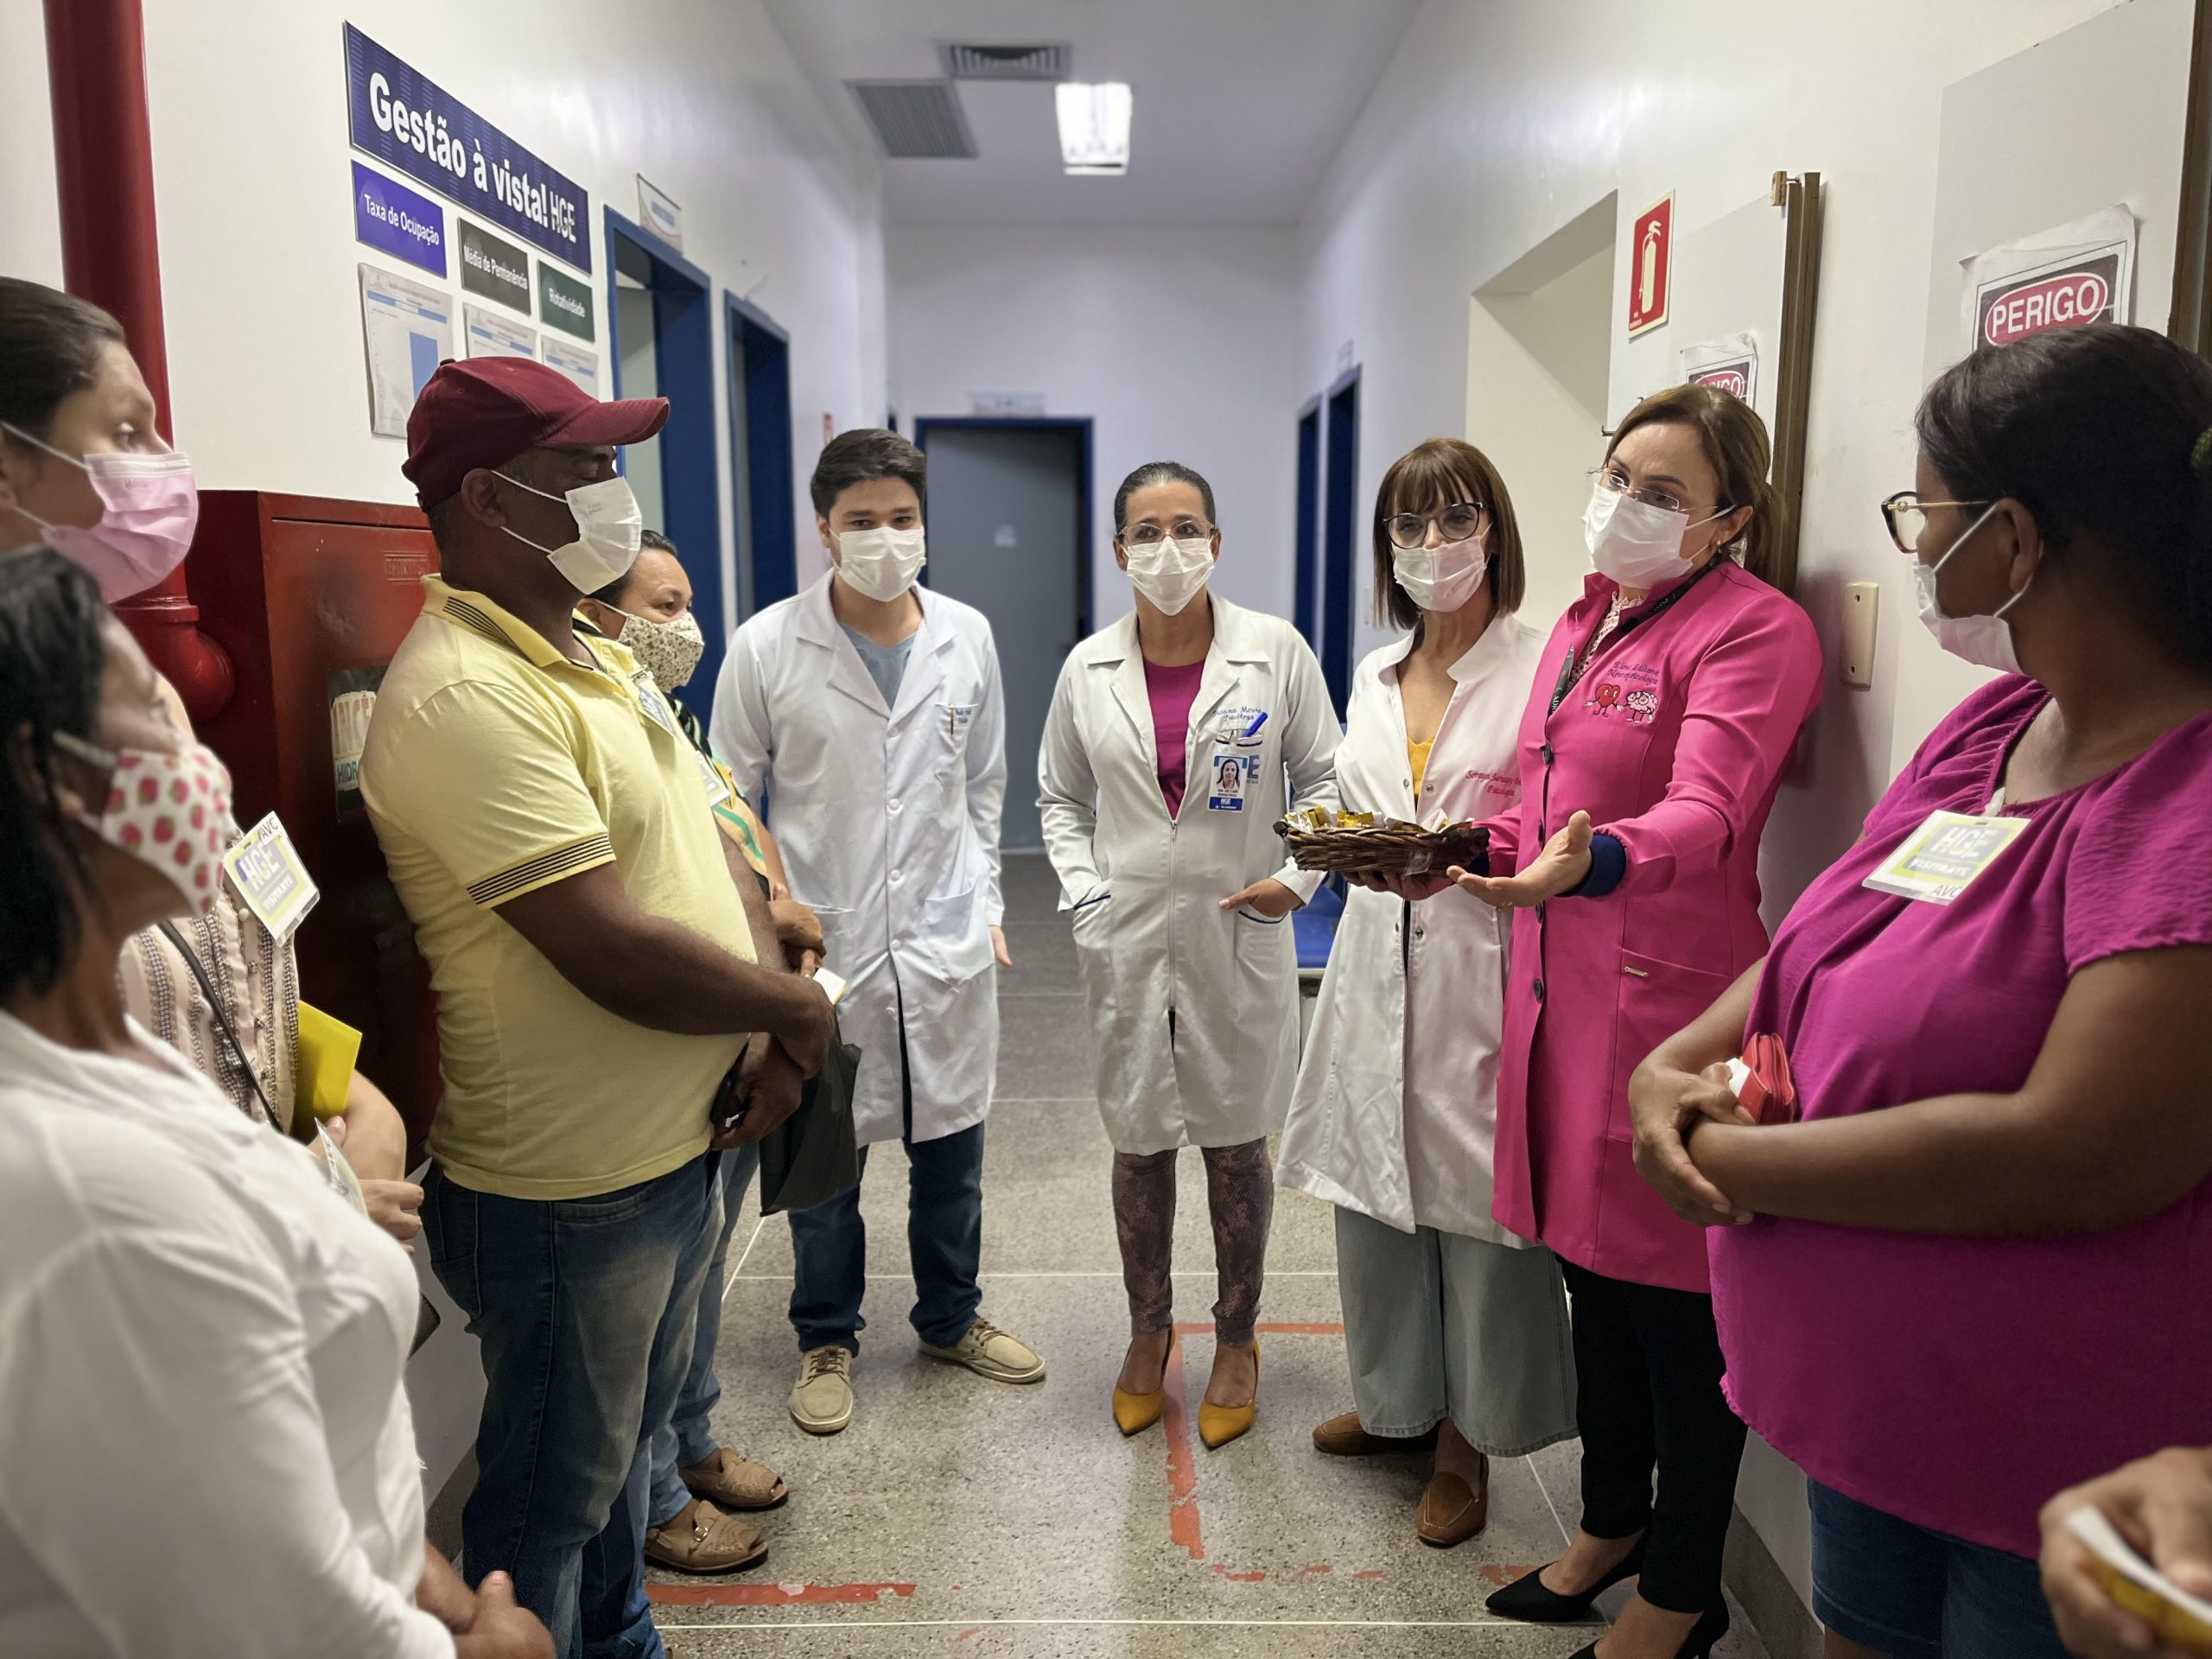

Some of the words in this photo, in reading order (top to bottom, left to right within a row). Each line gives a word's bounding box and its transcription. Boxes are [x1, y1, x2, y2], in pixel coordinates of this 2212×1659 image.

[370, 72, 467, 178] Gestão
[473, 138, 488, 192] à
[492, 158, 549, 228] vista!
[550, 191, 577, 243] HGE
[364, 193, 386, 221] Taxa
[388, 206, 399, 226] de
[400, 211, 439, 245] Ocupação
[483, 255, 491, 273] de
[549, 288, 585, 318] Rotatividade
[1993, 279, 2100, 338] PERIGO
[258, 817, 278, 840] AVC
[1910, 856, 1970, 877] VISITANTE
[1929, 885, 1963, 898] AVC
